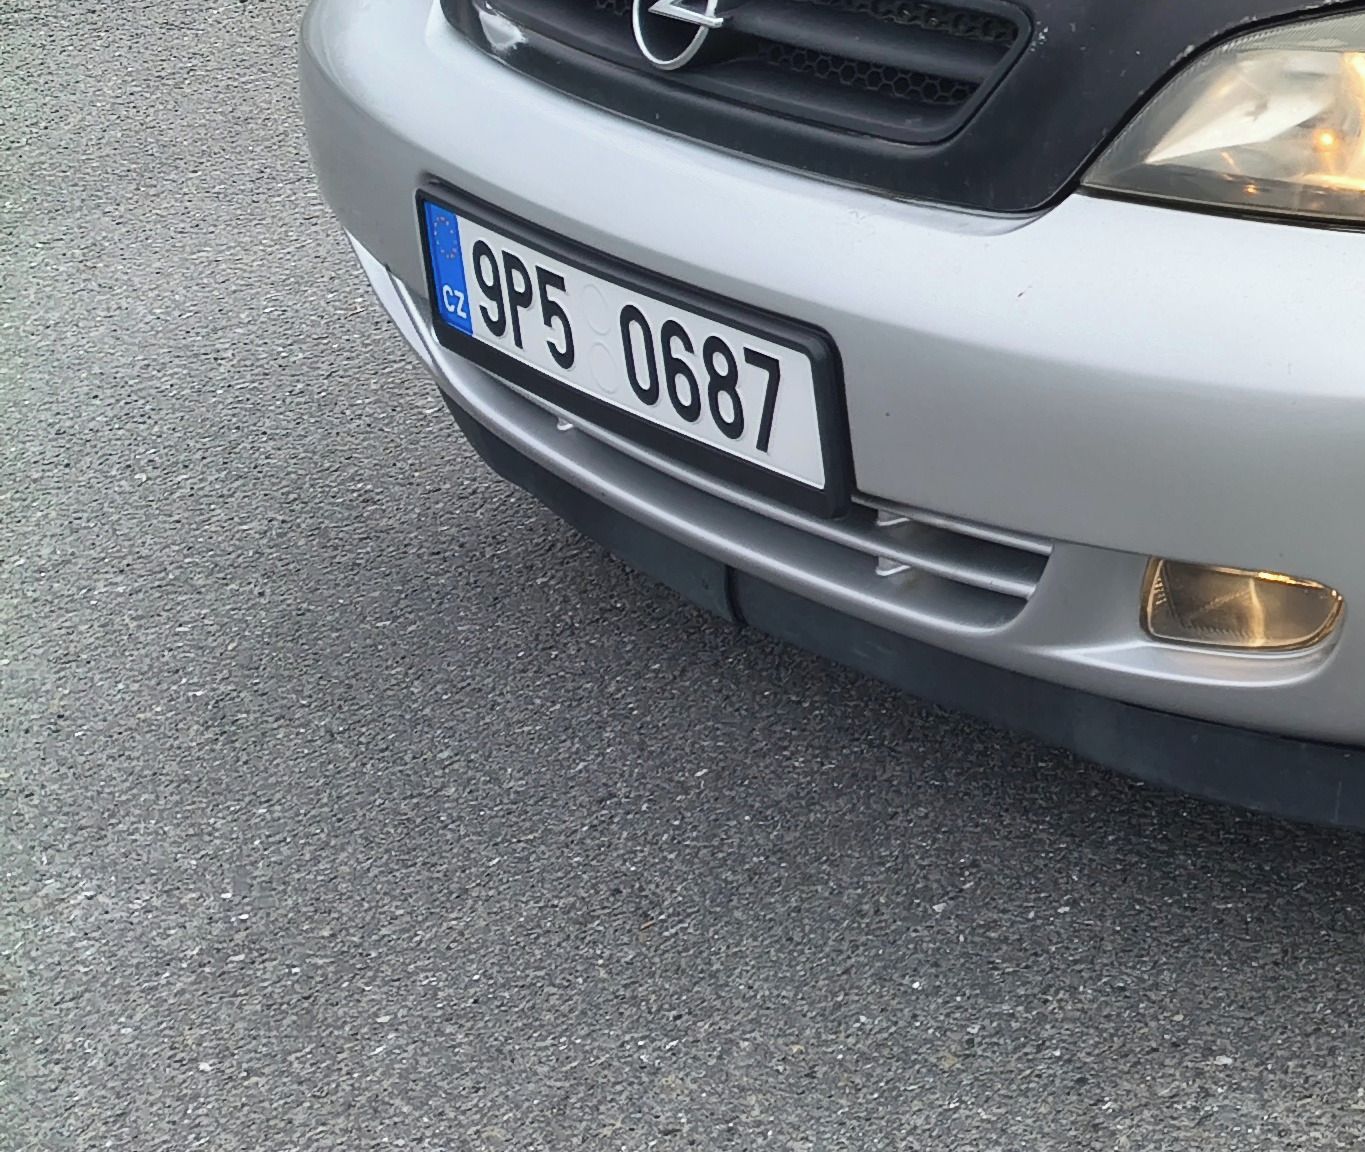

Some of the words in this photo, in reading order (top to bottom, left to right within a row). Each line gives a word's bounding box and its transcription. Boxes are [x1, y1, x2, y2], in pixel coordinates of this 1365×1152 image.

[442, 284, 468, 319] CZ
[472, 240, 575, 369] 9P5
[619, 304, 781, 453] 0687
